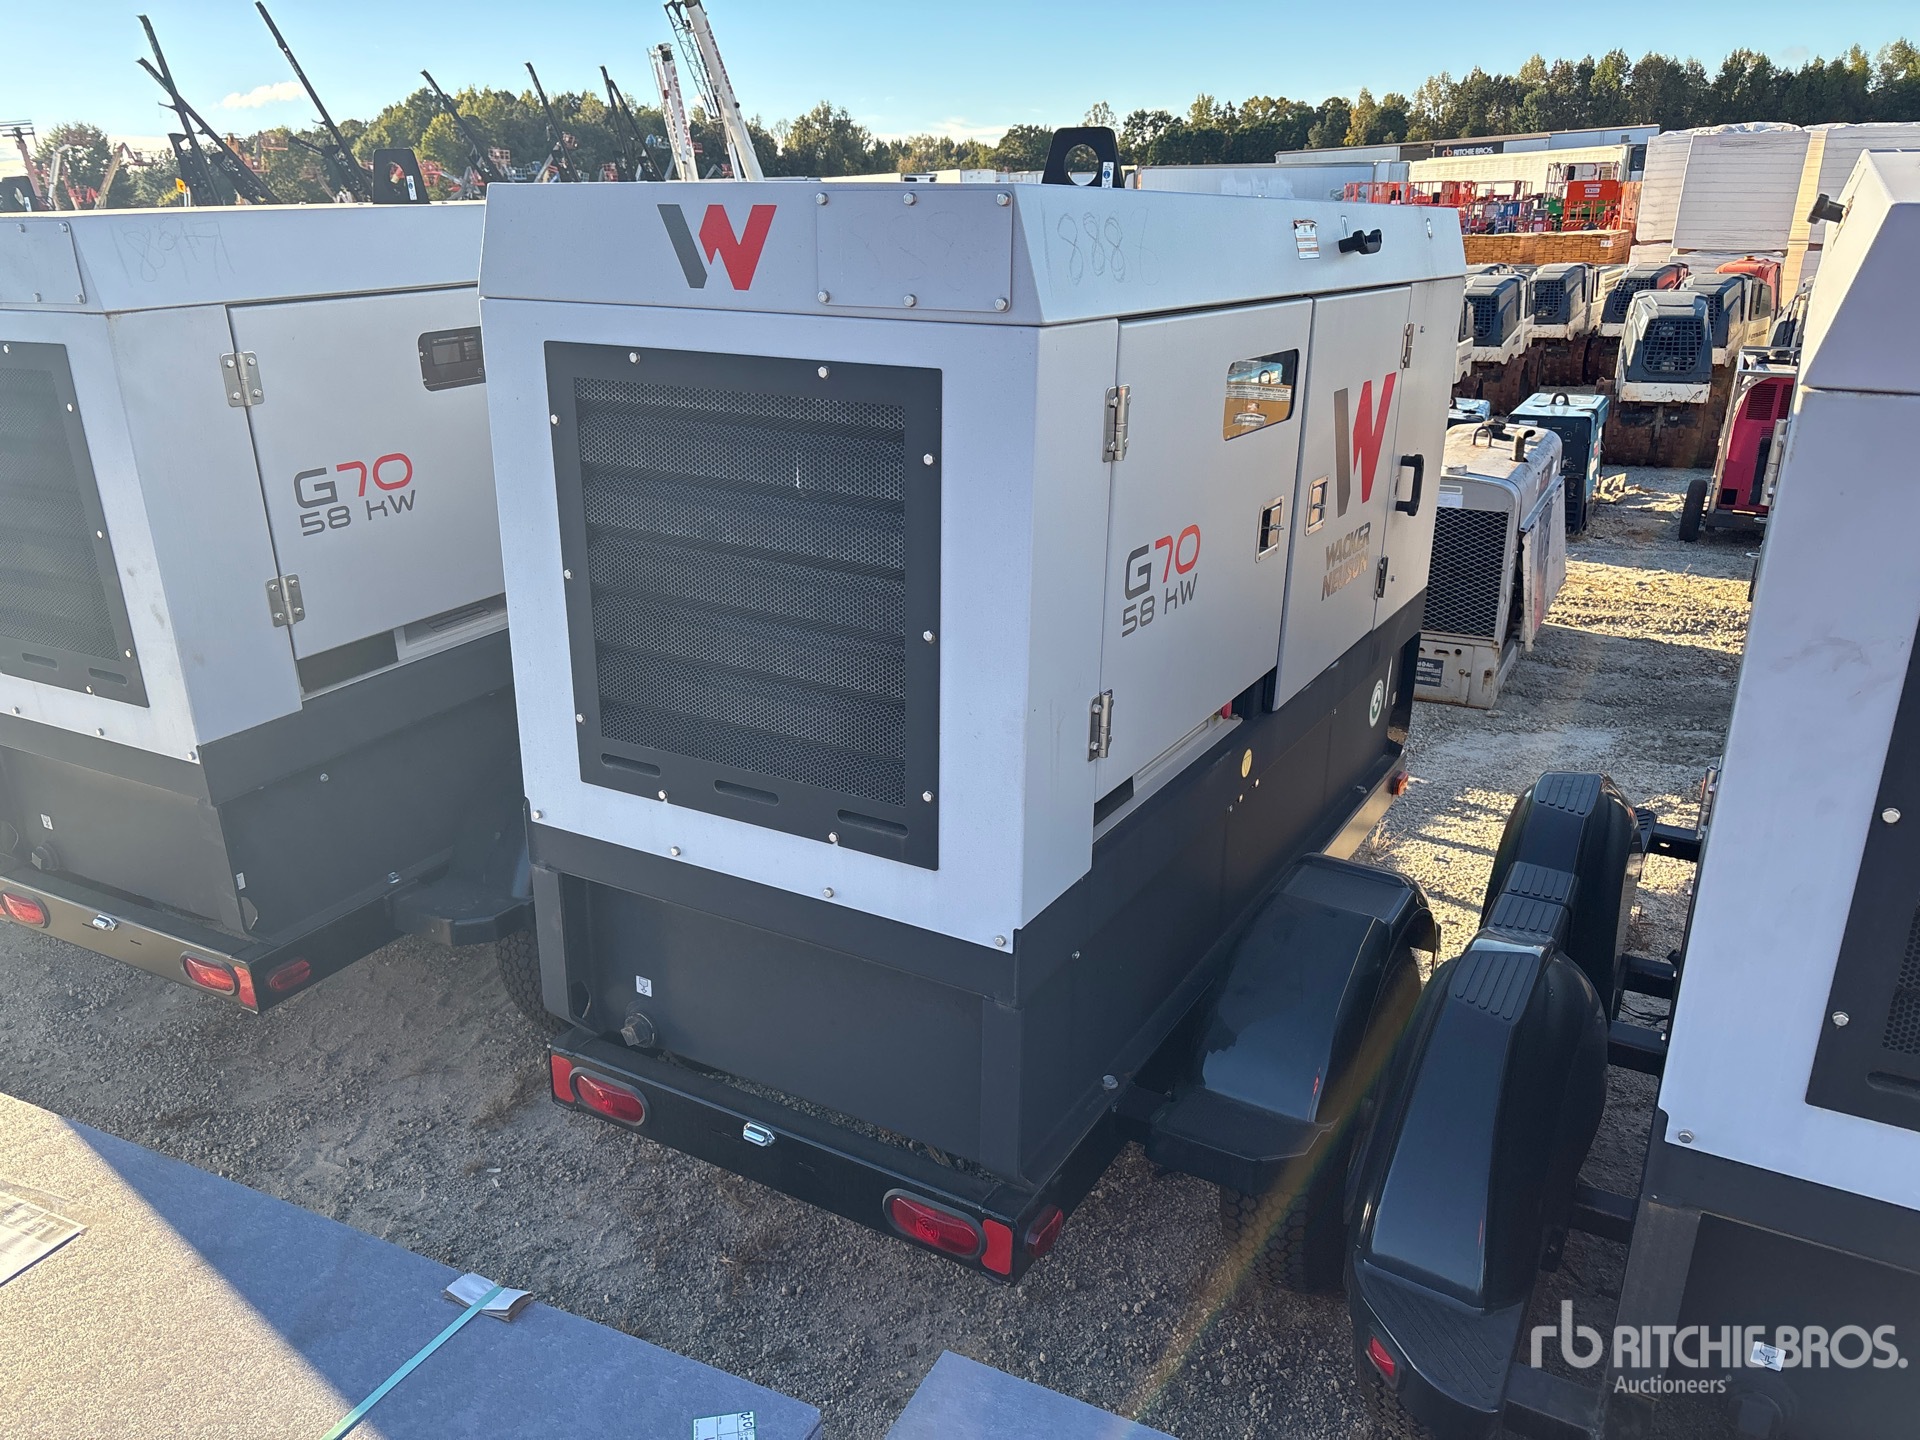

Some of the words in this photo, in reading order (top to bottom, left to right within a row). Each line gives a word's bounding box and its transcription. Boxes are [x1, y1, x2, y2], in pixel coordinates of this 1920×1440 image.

[1453, 147, 1475, 156] RITCHIE
[293, 452, 413, 509] G70
[300, 505, 352, 537] 58
[1125, 524, 1201, 601] G70
[1325, 522, 1372, 570] WACKER
[1320, 549, 1370, 602] NEUSON
[1121, 595, 1156, 638] 58
